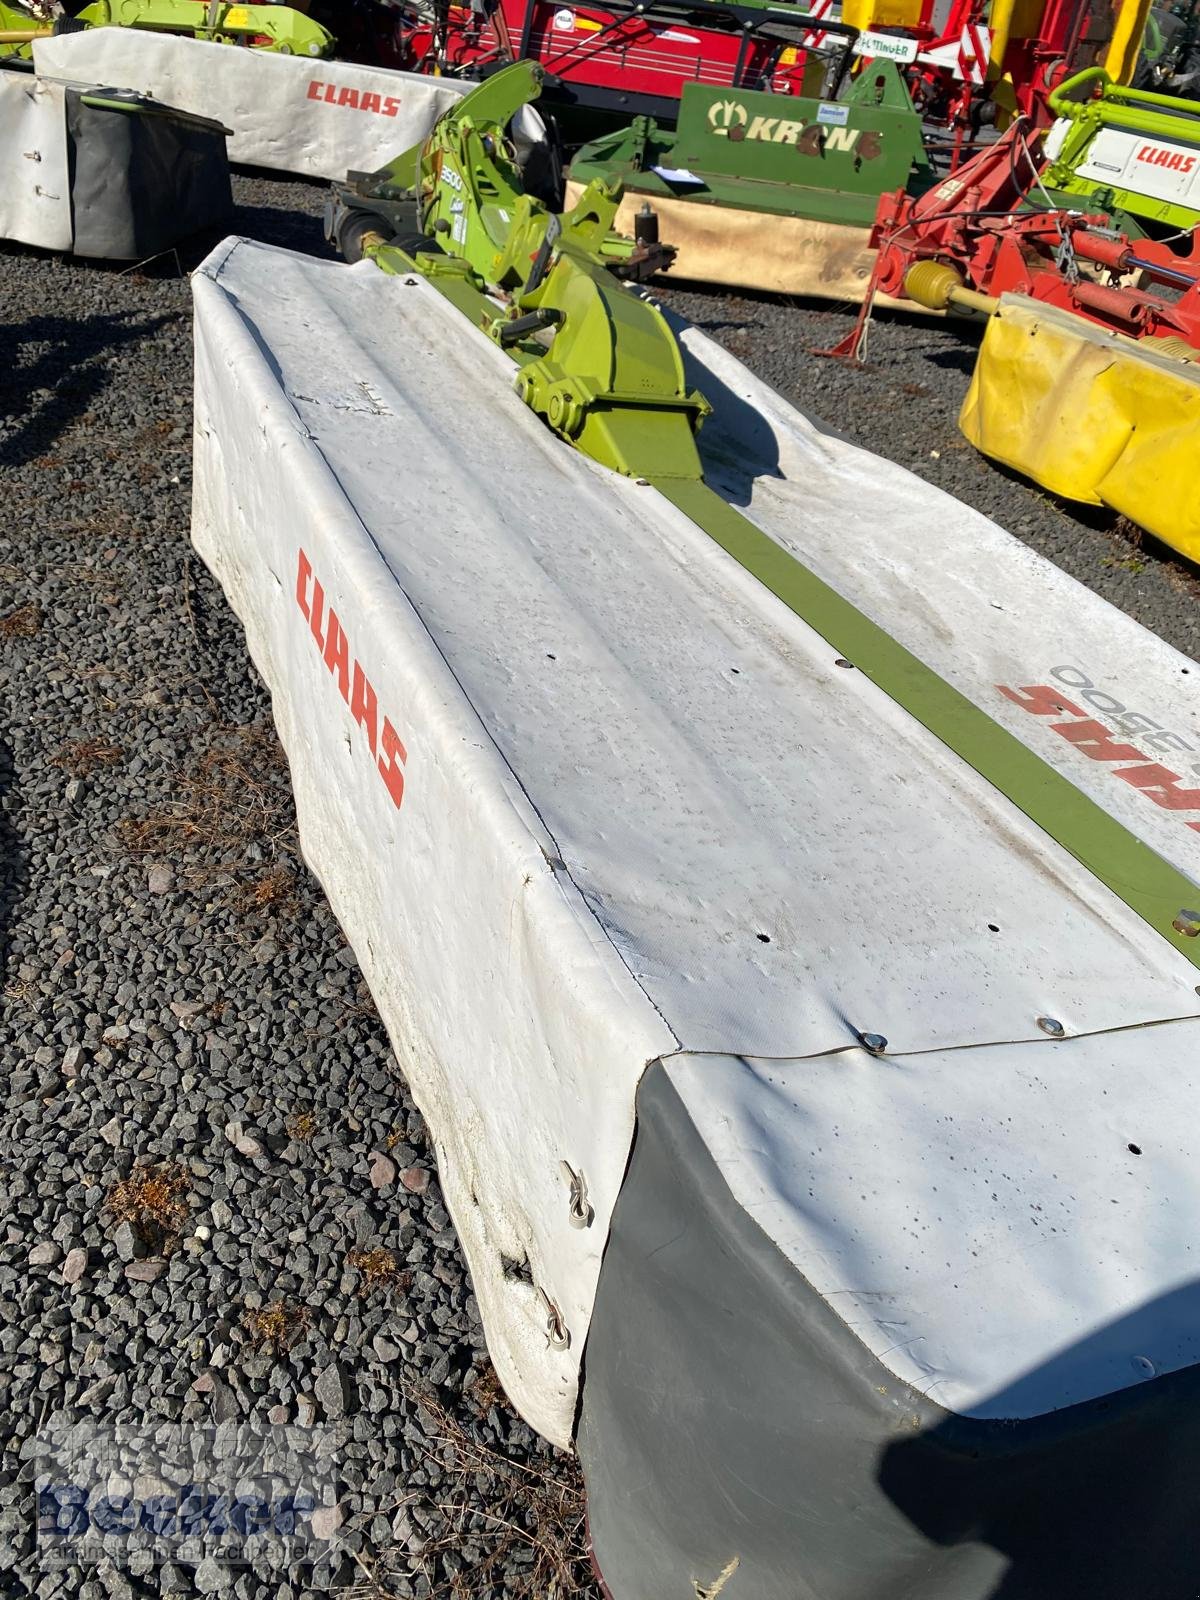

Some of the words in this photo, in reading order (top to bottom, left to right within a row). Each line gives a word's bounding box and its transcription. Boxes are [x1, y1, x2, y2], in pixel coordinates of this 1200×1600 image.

[307, 81, 401, 117] CLAAS
[1137, 145, 1197, 173] CLAAS
[296, 547, 407, 810] CLAAS
[1050, 665, 1195, 752] 3500
